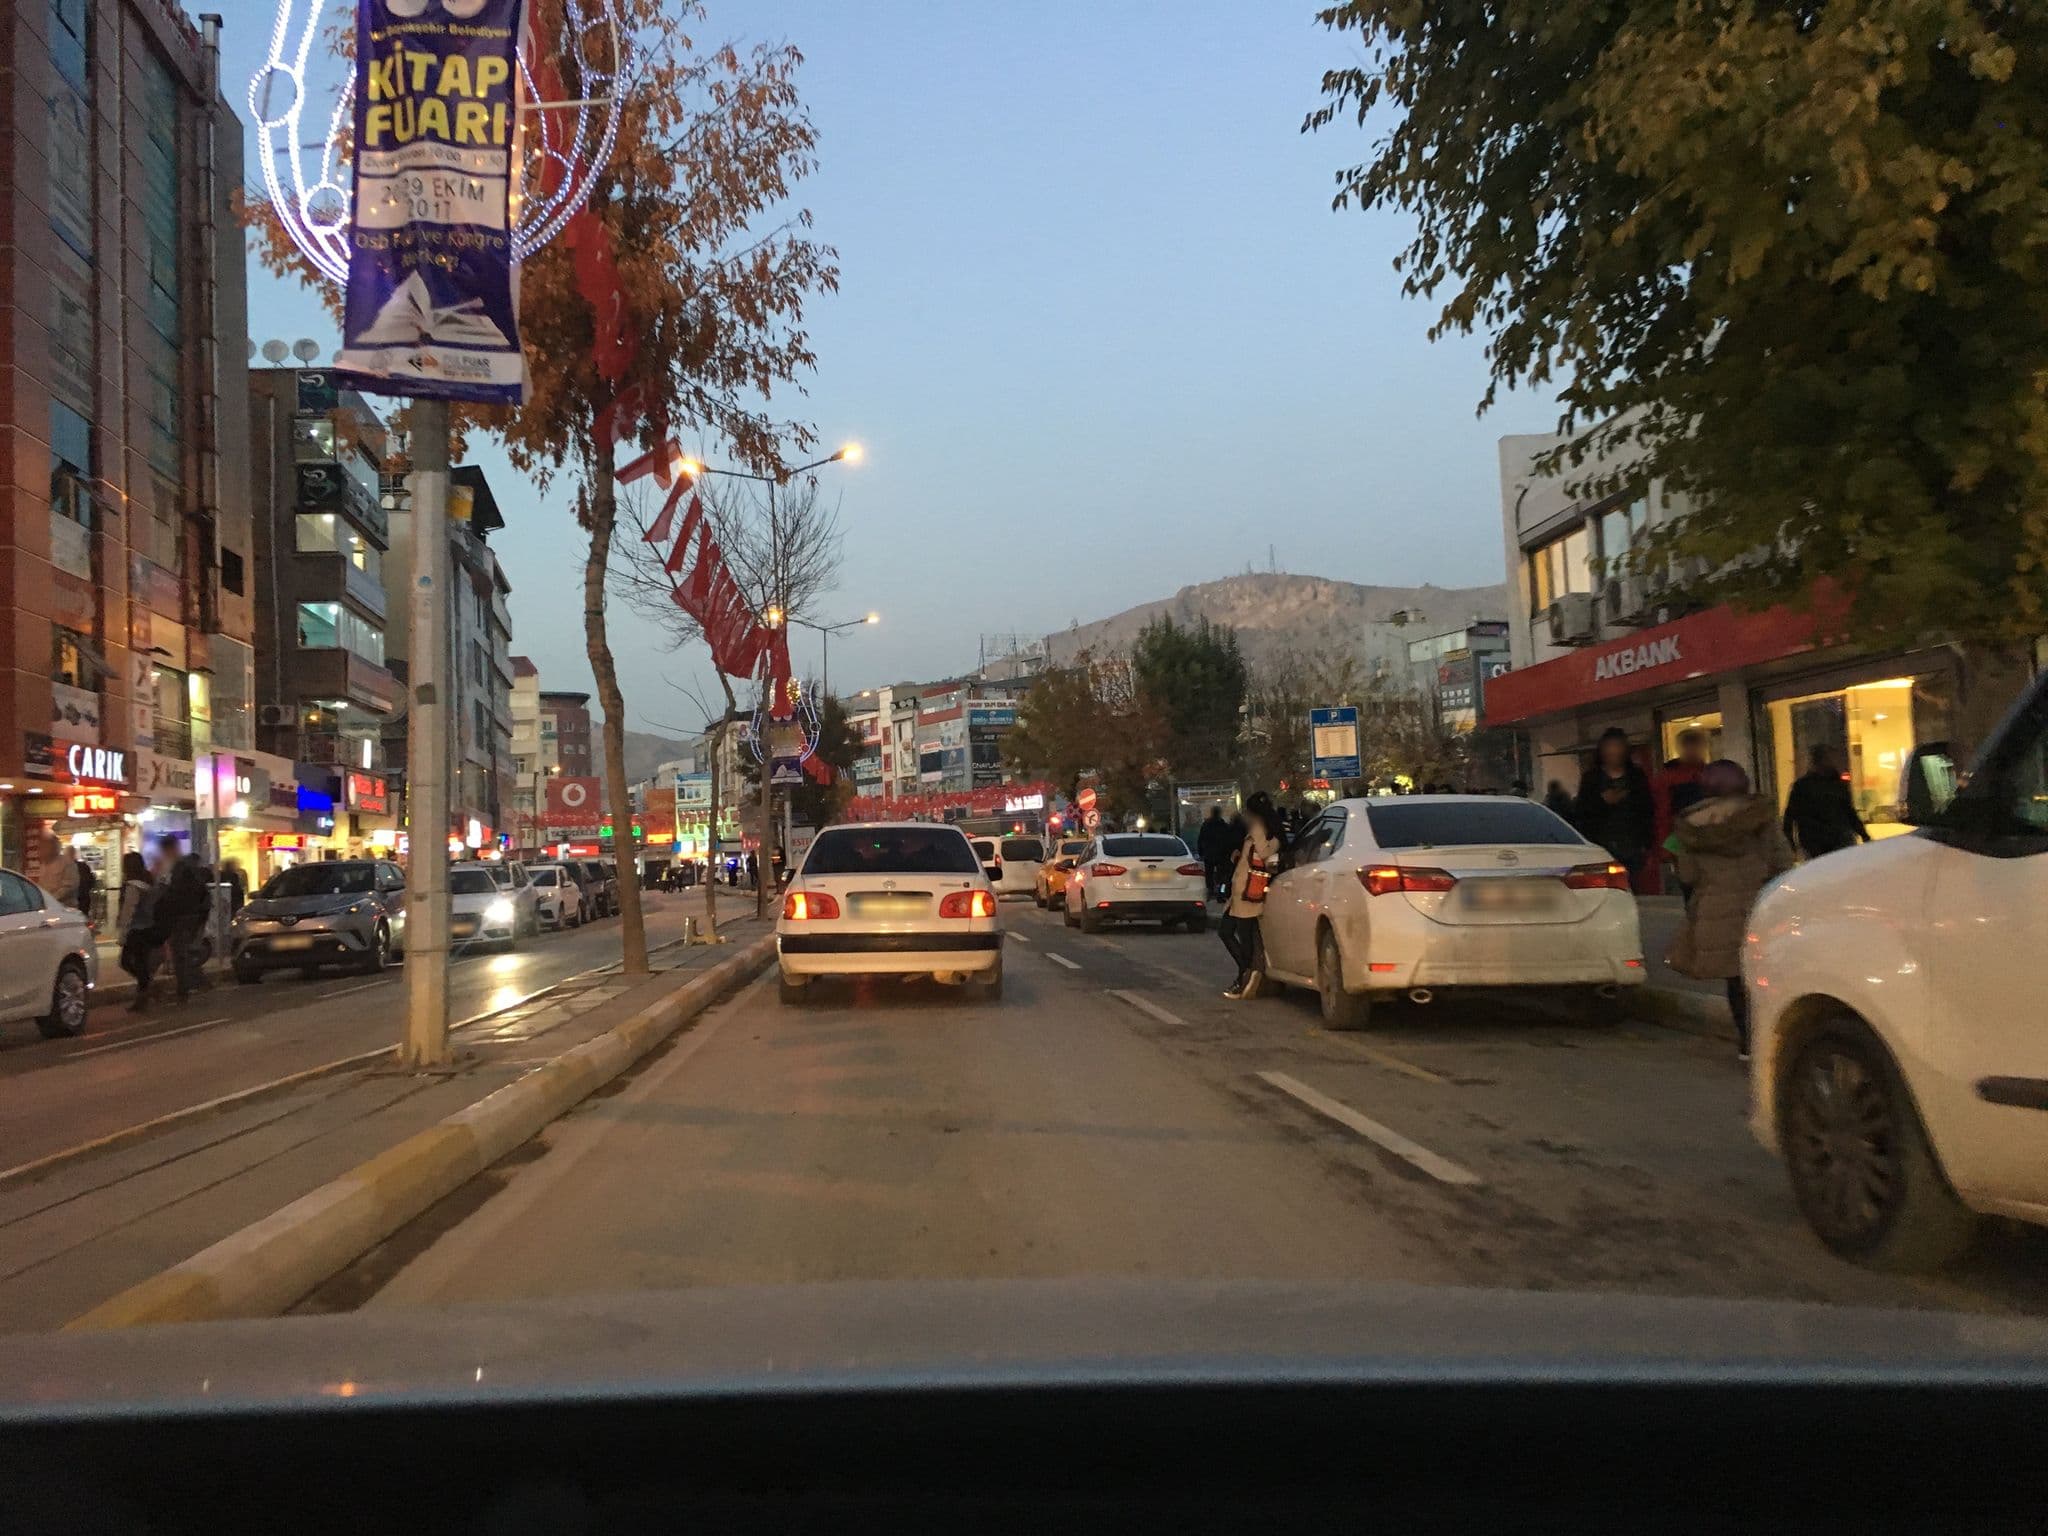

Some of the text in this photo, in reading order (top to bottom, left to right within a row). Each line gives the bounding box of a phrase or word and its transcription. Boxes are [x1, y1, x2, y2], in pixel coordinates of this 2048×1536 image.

[368, 40, 509, 101] KİTAP
[365, 99, 507, 147] FUARI
[1595, 634, 1683, 681] AKBANK
